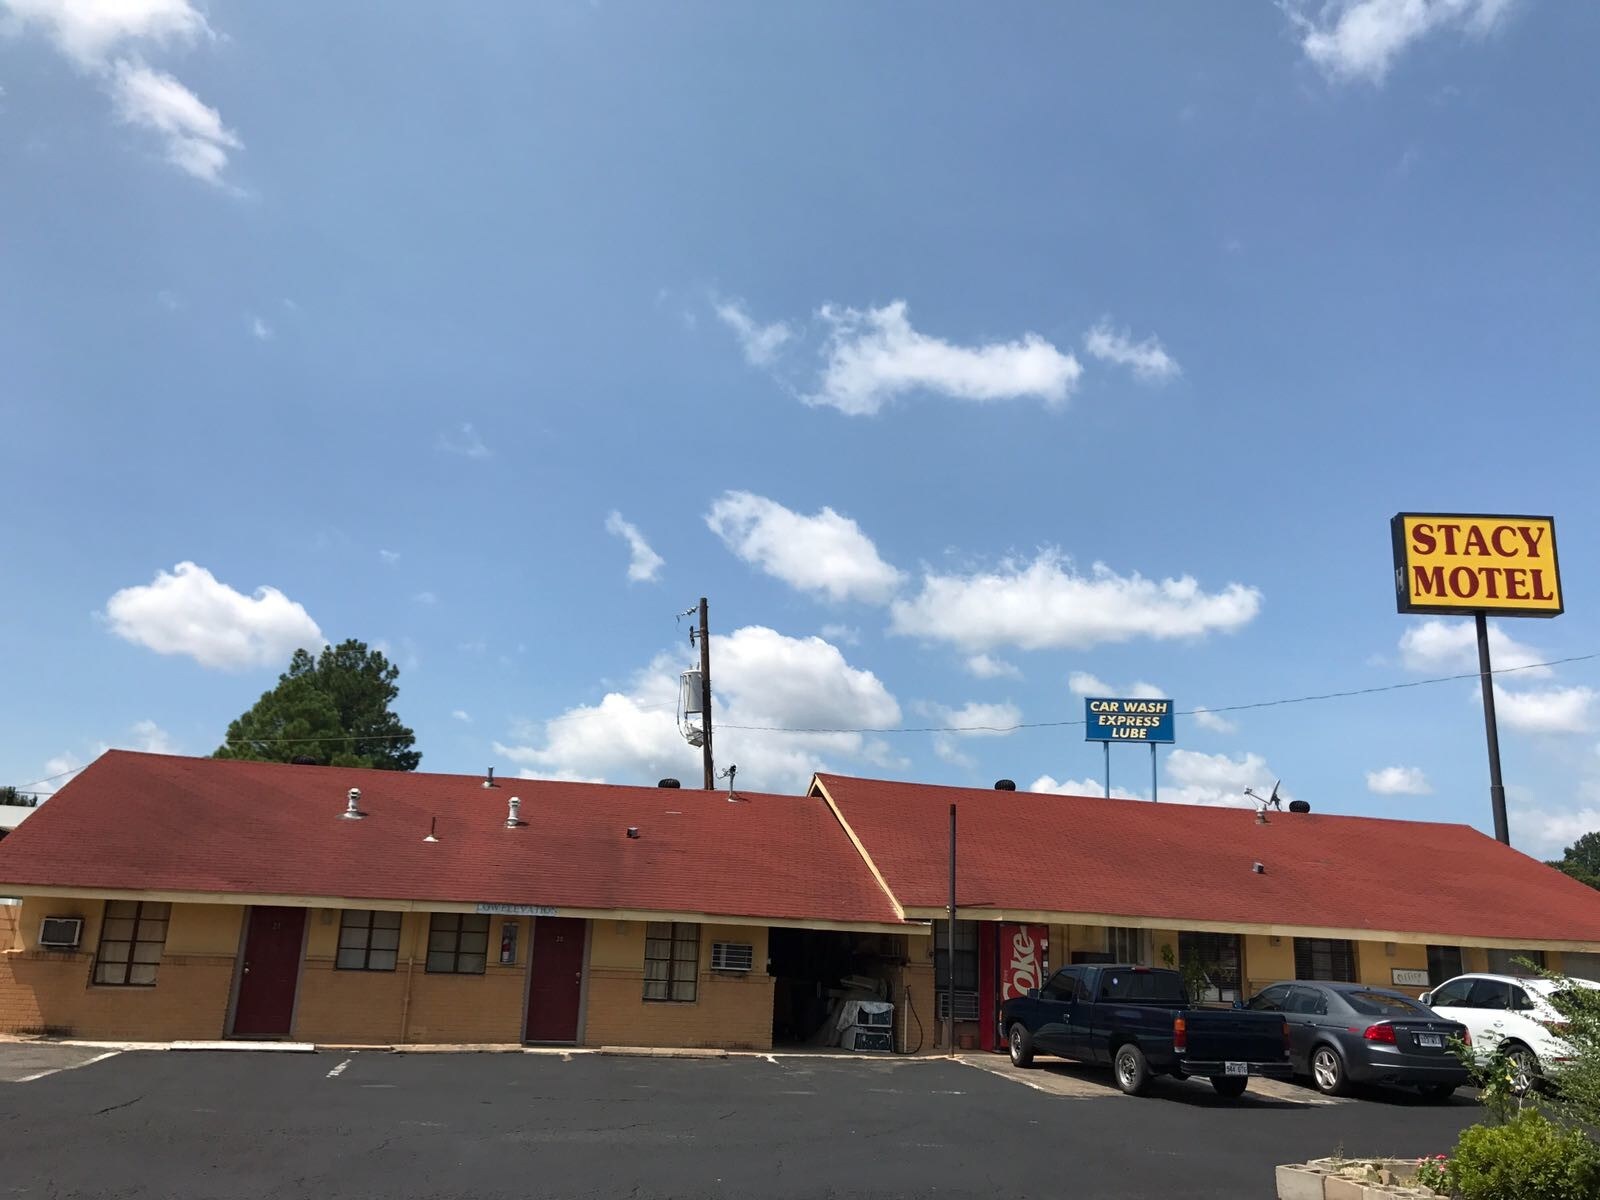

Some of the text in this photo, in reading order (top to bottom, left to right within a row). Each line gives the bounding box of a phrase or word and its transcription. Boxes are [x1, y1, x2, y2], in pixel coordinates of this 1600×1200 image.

[1412, 523, 1545, 558] STACY
[1412, 565, 1554, 601] MOTEL
[1090, 701, 1168, 713] CAR WASH
[1098, 715, 1160, 727] EXPRESS
[1111, 727, 1148, 739] LUBE
